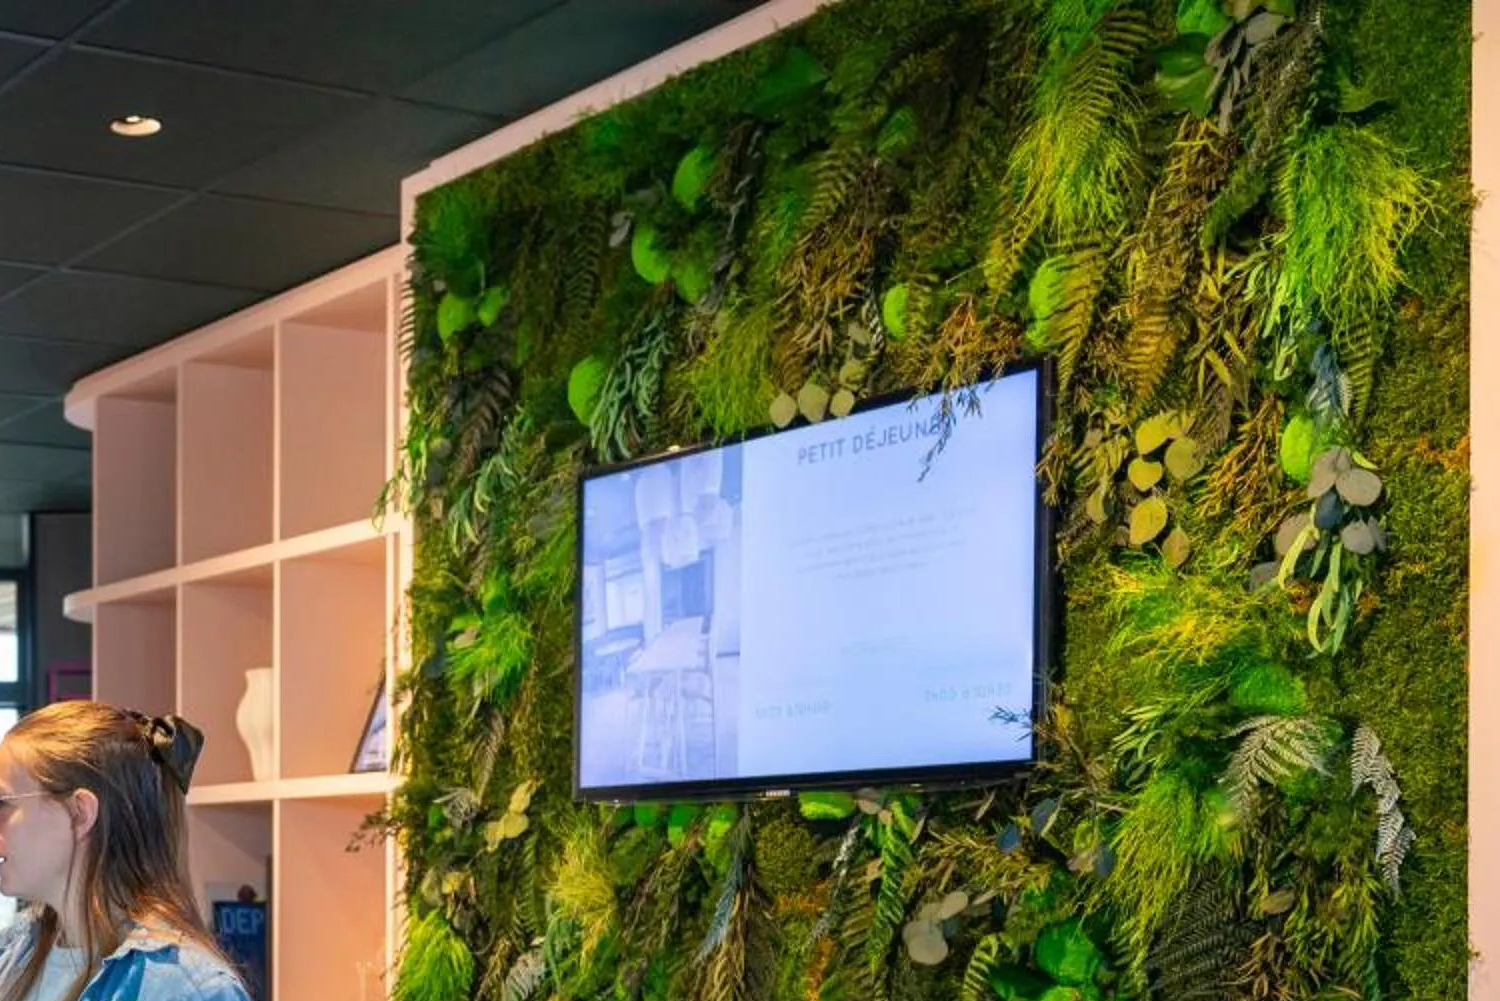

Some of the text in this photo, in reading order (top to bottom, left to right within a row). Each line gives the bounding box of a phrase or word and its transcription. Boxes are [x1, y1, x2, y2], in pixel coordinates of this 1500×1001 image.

[797, 413, 951, 465] PETIT DÉJEUNE
[221, 907, 264, 935] DEP
